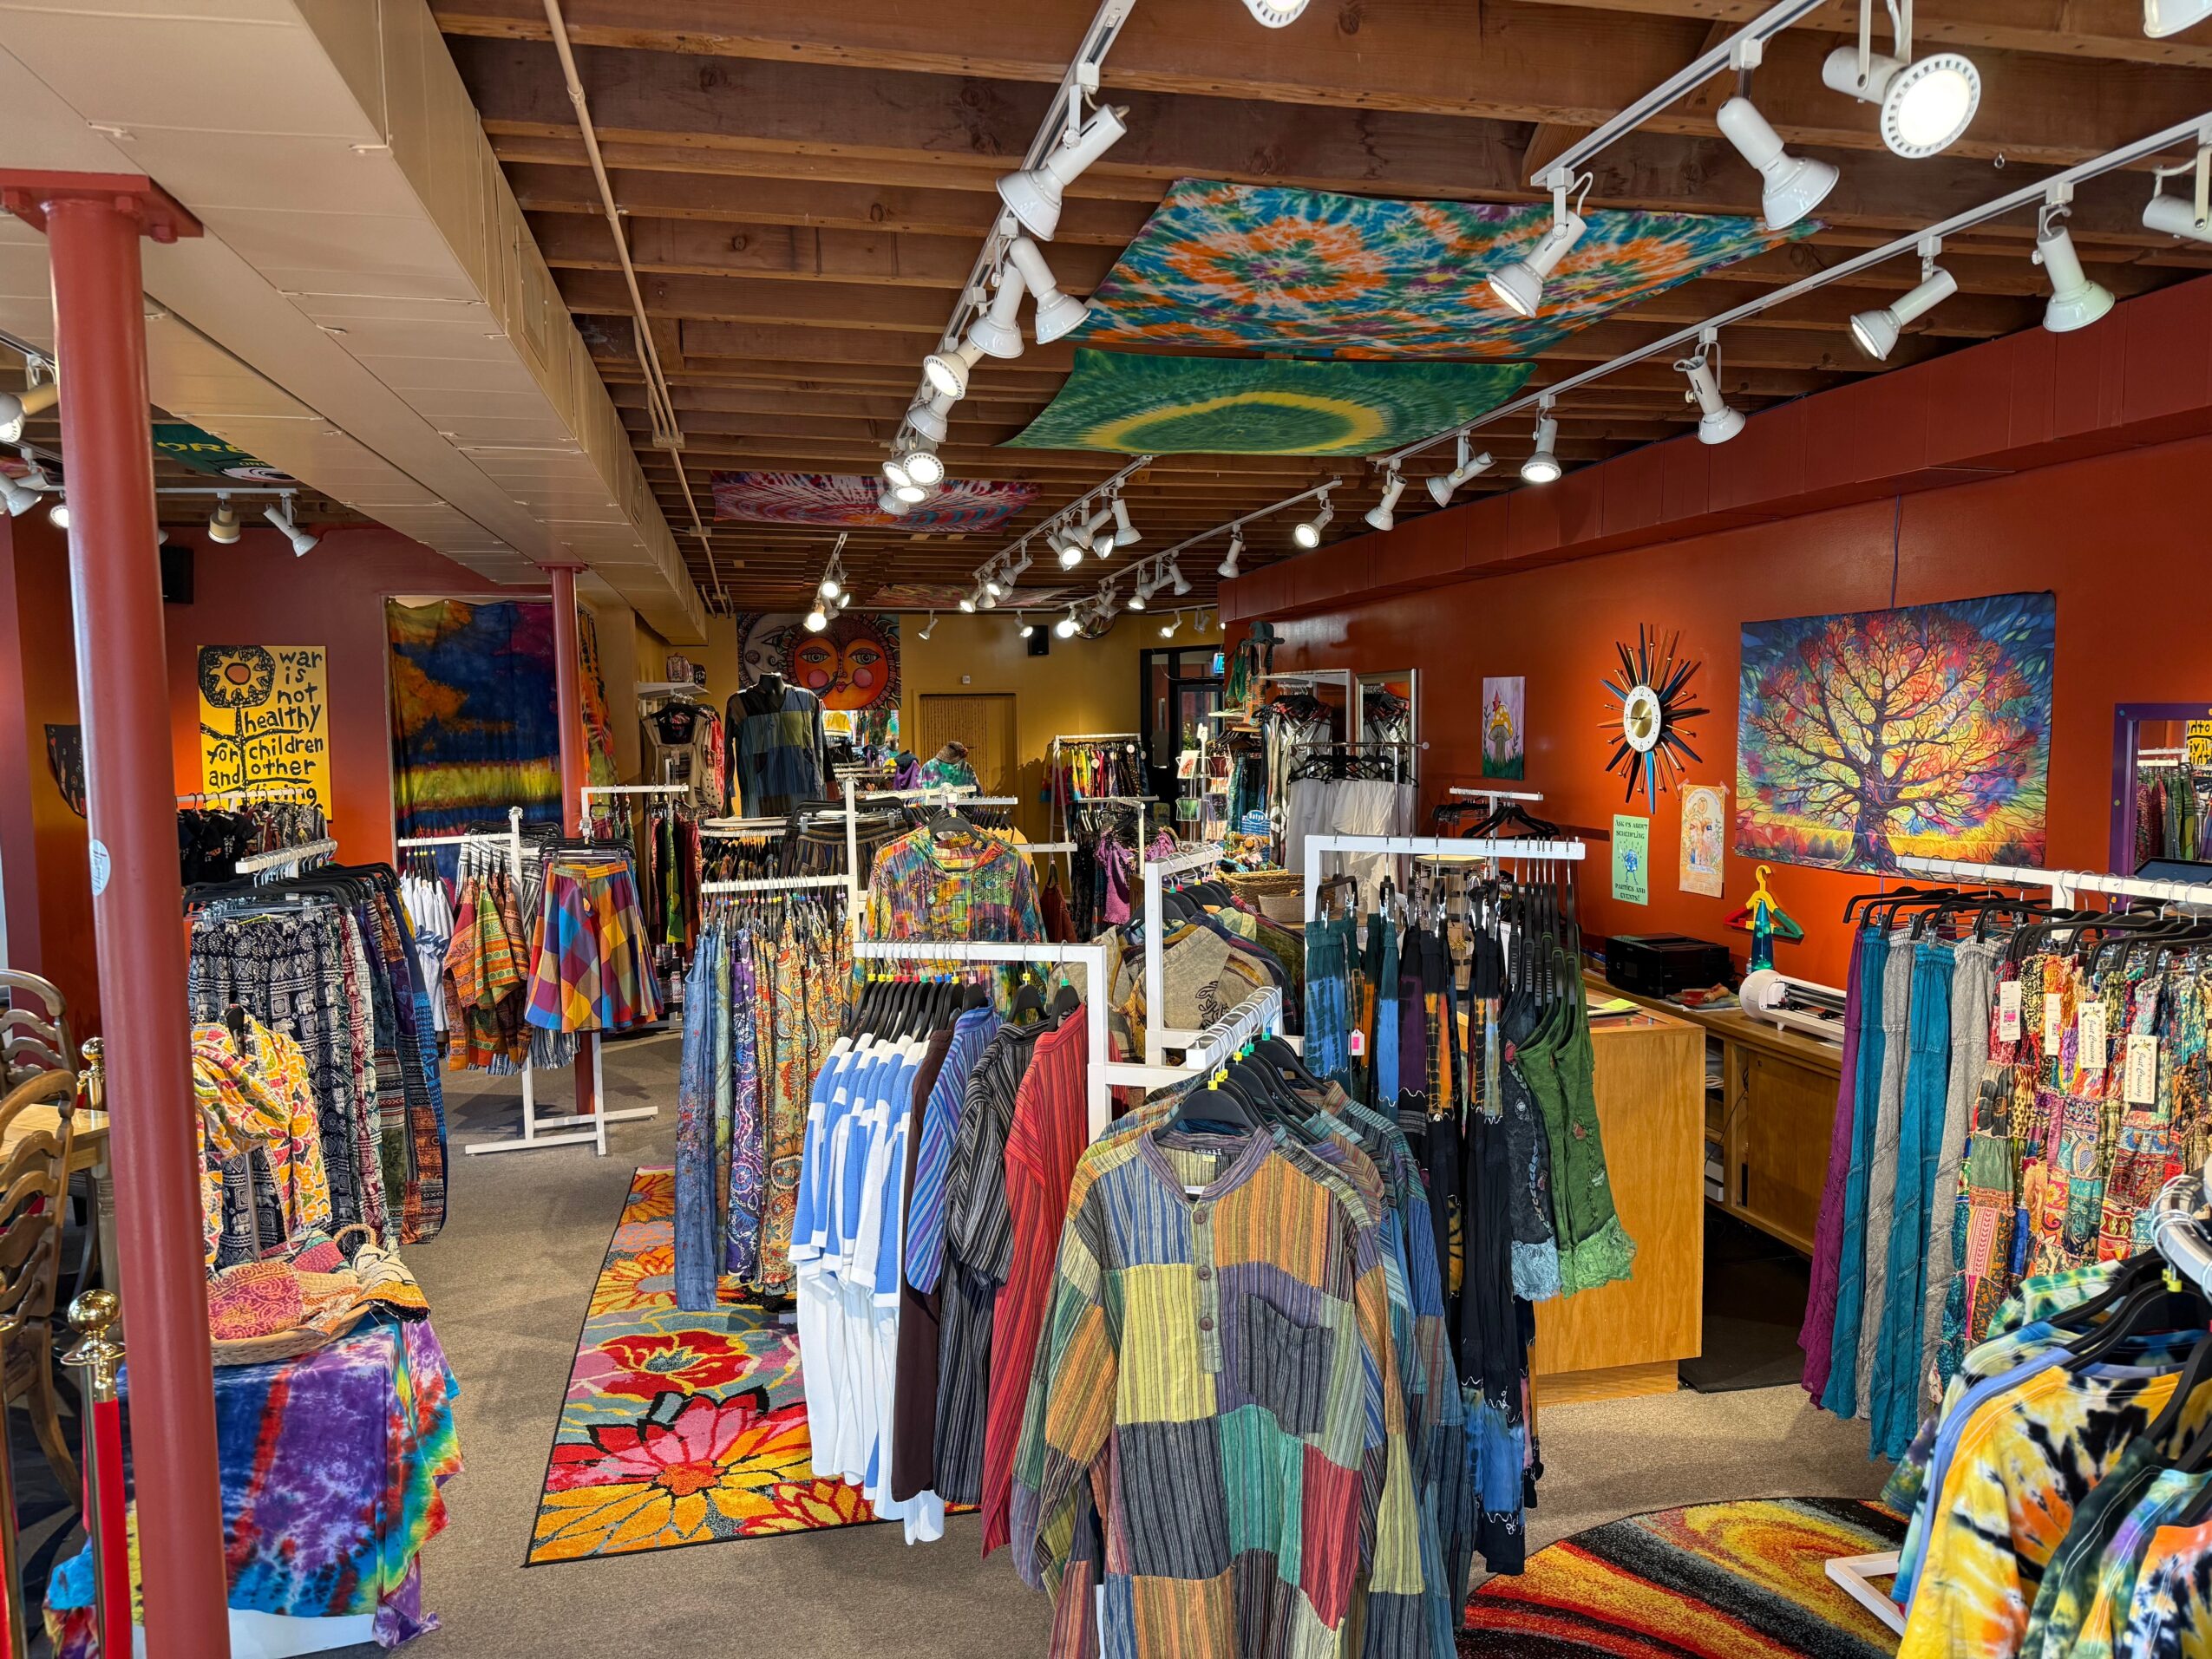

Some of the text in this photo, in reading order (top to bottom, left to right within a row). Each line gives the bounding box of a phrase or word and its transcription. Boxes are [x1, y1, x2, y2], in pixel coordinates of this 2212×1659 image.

[279, 650, 323, 669] war
[285, 666, 306, 685] is
[278, 682, 317, 705] not
[1639, 688, 1645, 696] 12
[245, 704, 322, 733] healthy
[1654, 715, 1659, 724] 3
[206, 735, 324, 765] for children
[1639, 741, 1644, 751] 6
[209, 758, 317, 788] and other
[2087, 1018, 2097, 1063] Just Cruising
[2136, 1051, 2147, 1098] Just Cruising
